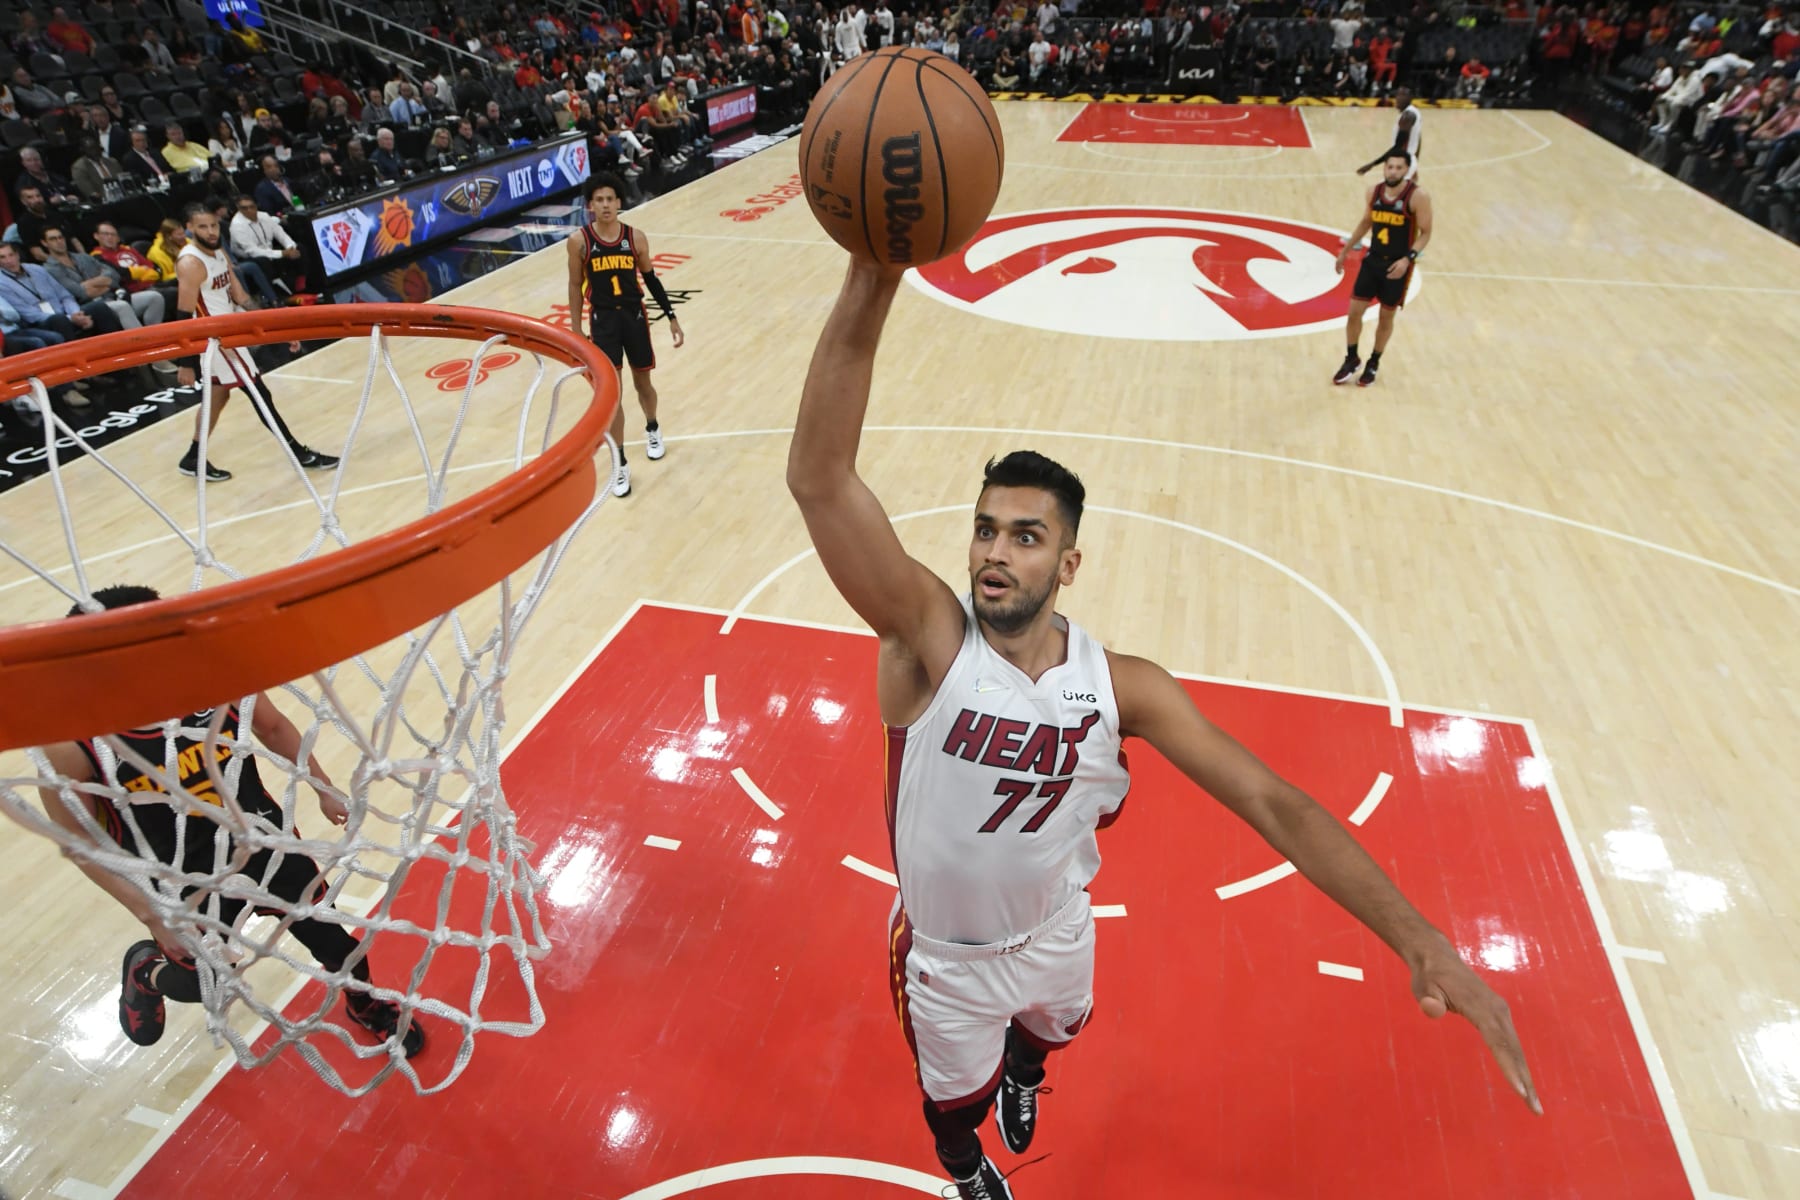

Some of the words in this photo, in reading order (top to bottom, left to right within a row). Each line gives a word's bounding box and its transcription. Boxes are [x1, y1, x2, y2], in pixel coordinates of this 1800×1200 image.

[421, 202, 436, 223] VS
[507, 166, 534, 199] NEXT
[591, 254, 634, 272] HAWKS
[1377, 227, 1389, 245] 4
[610, 275, 622, 296] 1
[7, 403, 157, 464] Google
[942, 708, 1101, 777] HEAT
[976, 777, 1075, 833] 77
